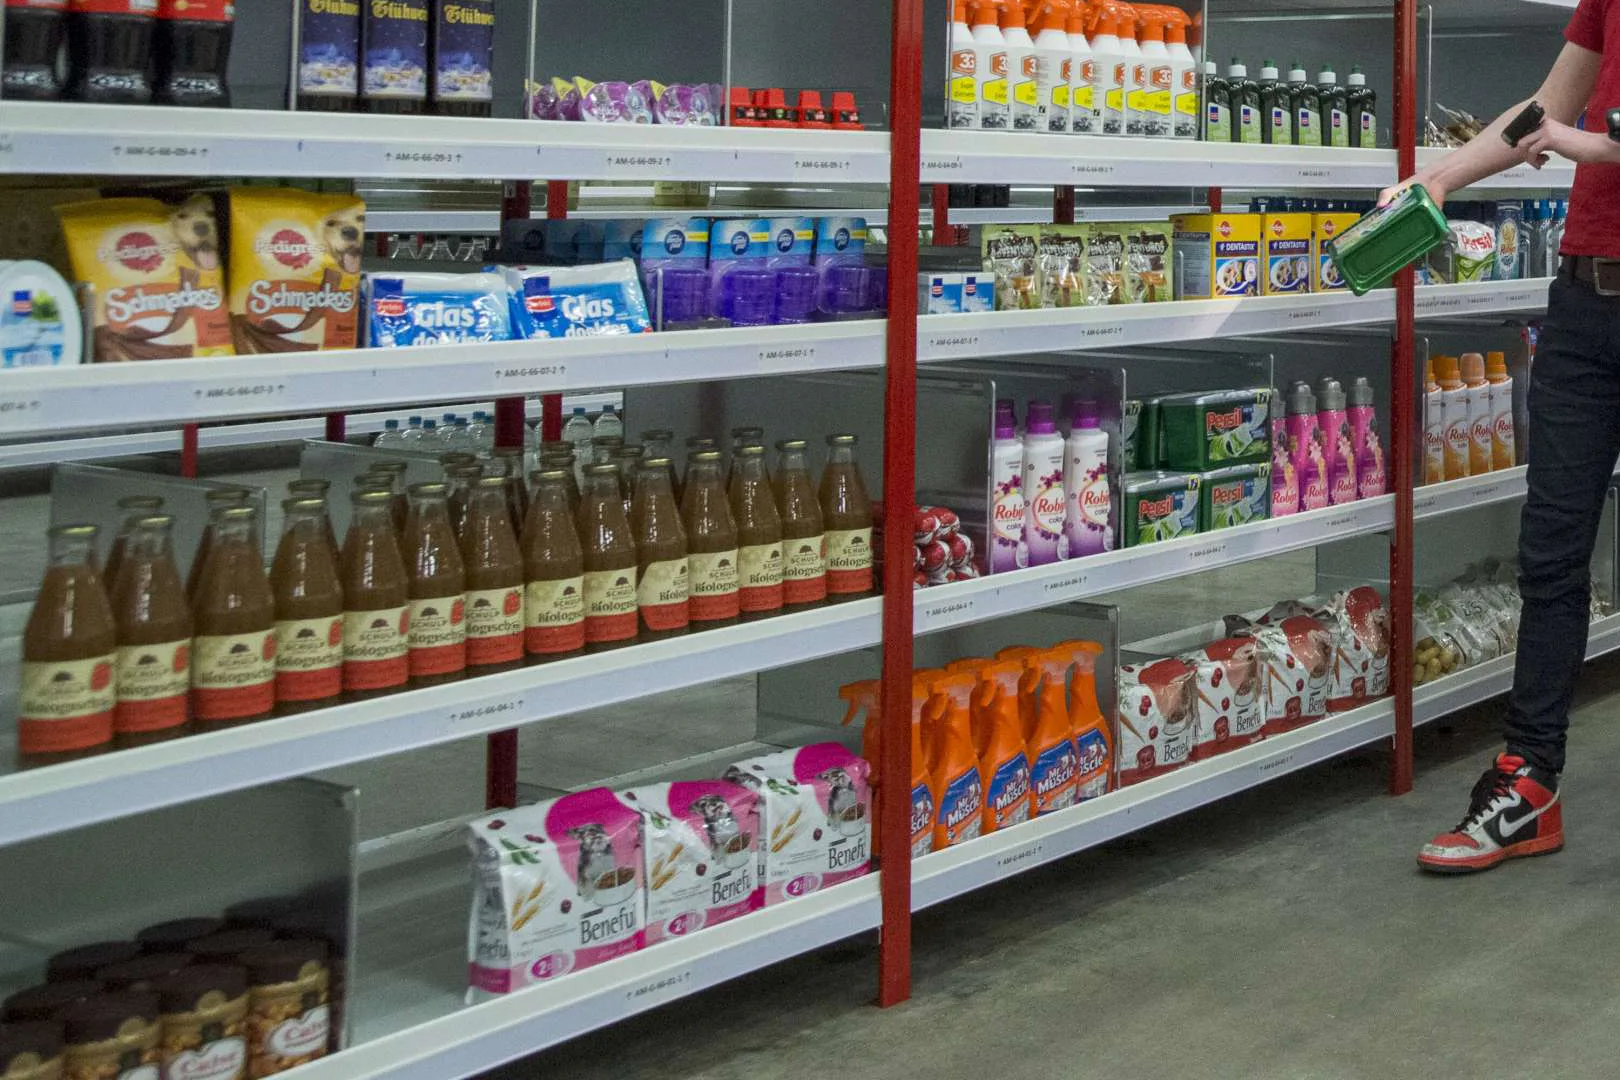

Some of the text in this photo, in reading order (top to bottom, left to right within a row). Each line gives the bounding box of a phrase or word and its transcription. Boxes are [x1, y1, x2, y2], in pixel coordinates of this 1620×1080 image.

[106, 281, 222, 322] Schmackos
[250, 280, 353, 314] Schmackos
[562, 294, 615, 321] Glas
[413, 301, 475, 329] Glas
[1206, 408, 1243, 430] Persil
[1138, 494, 1175, 518] Persil
[1211, 483, 1243, 504] Persil
